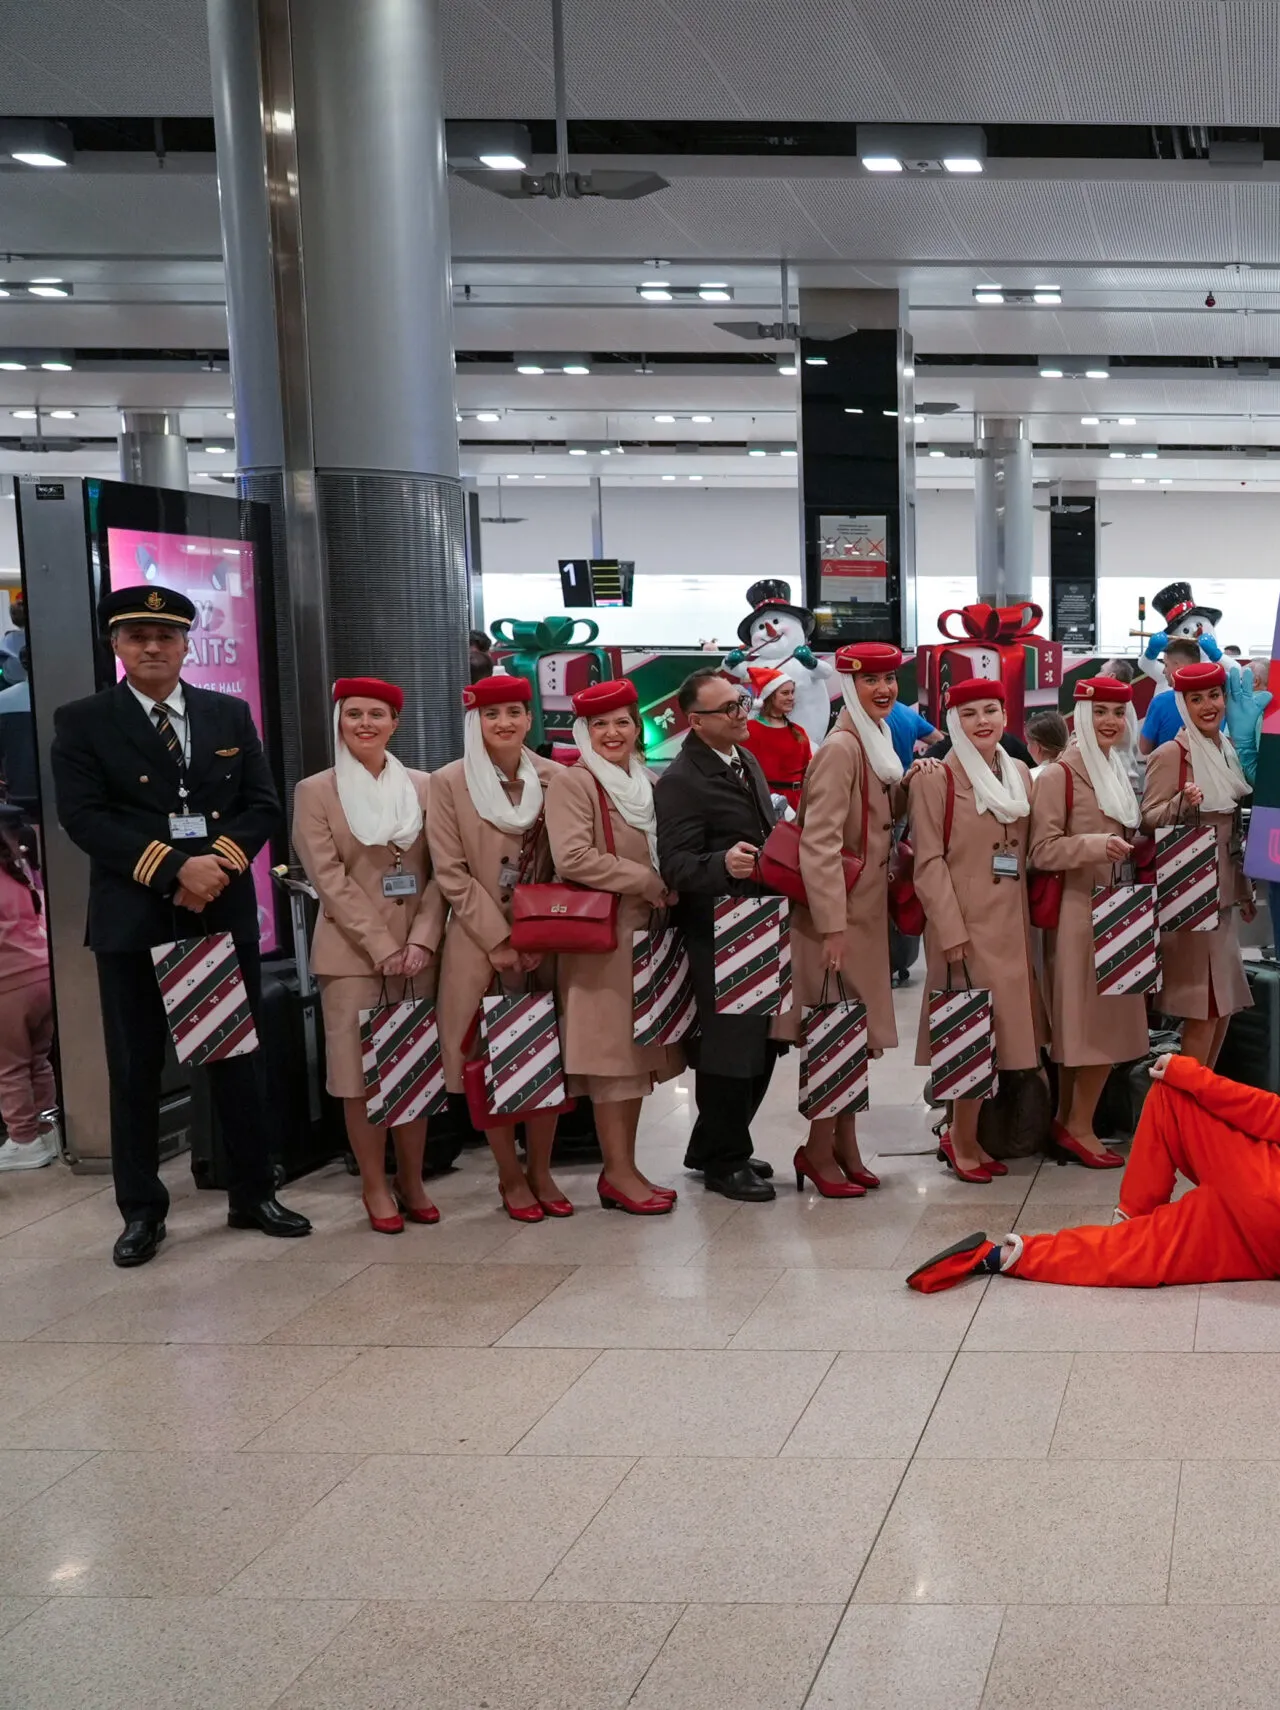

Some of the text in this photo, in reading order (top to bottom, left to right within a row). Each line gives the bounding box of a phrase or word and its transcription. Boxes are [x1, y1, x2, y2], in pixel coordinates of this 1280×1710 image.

[563, 562, 576, 587] 1
[182, 637, 238, 667] AITS
[219, 681, 242, 694] HALL
